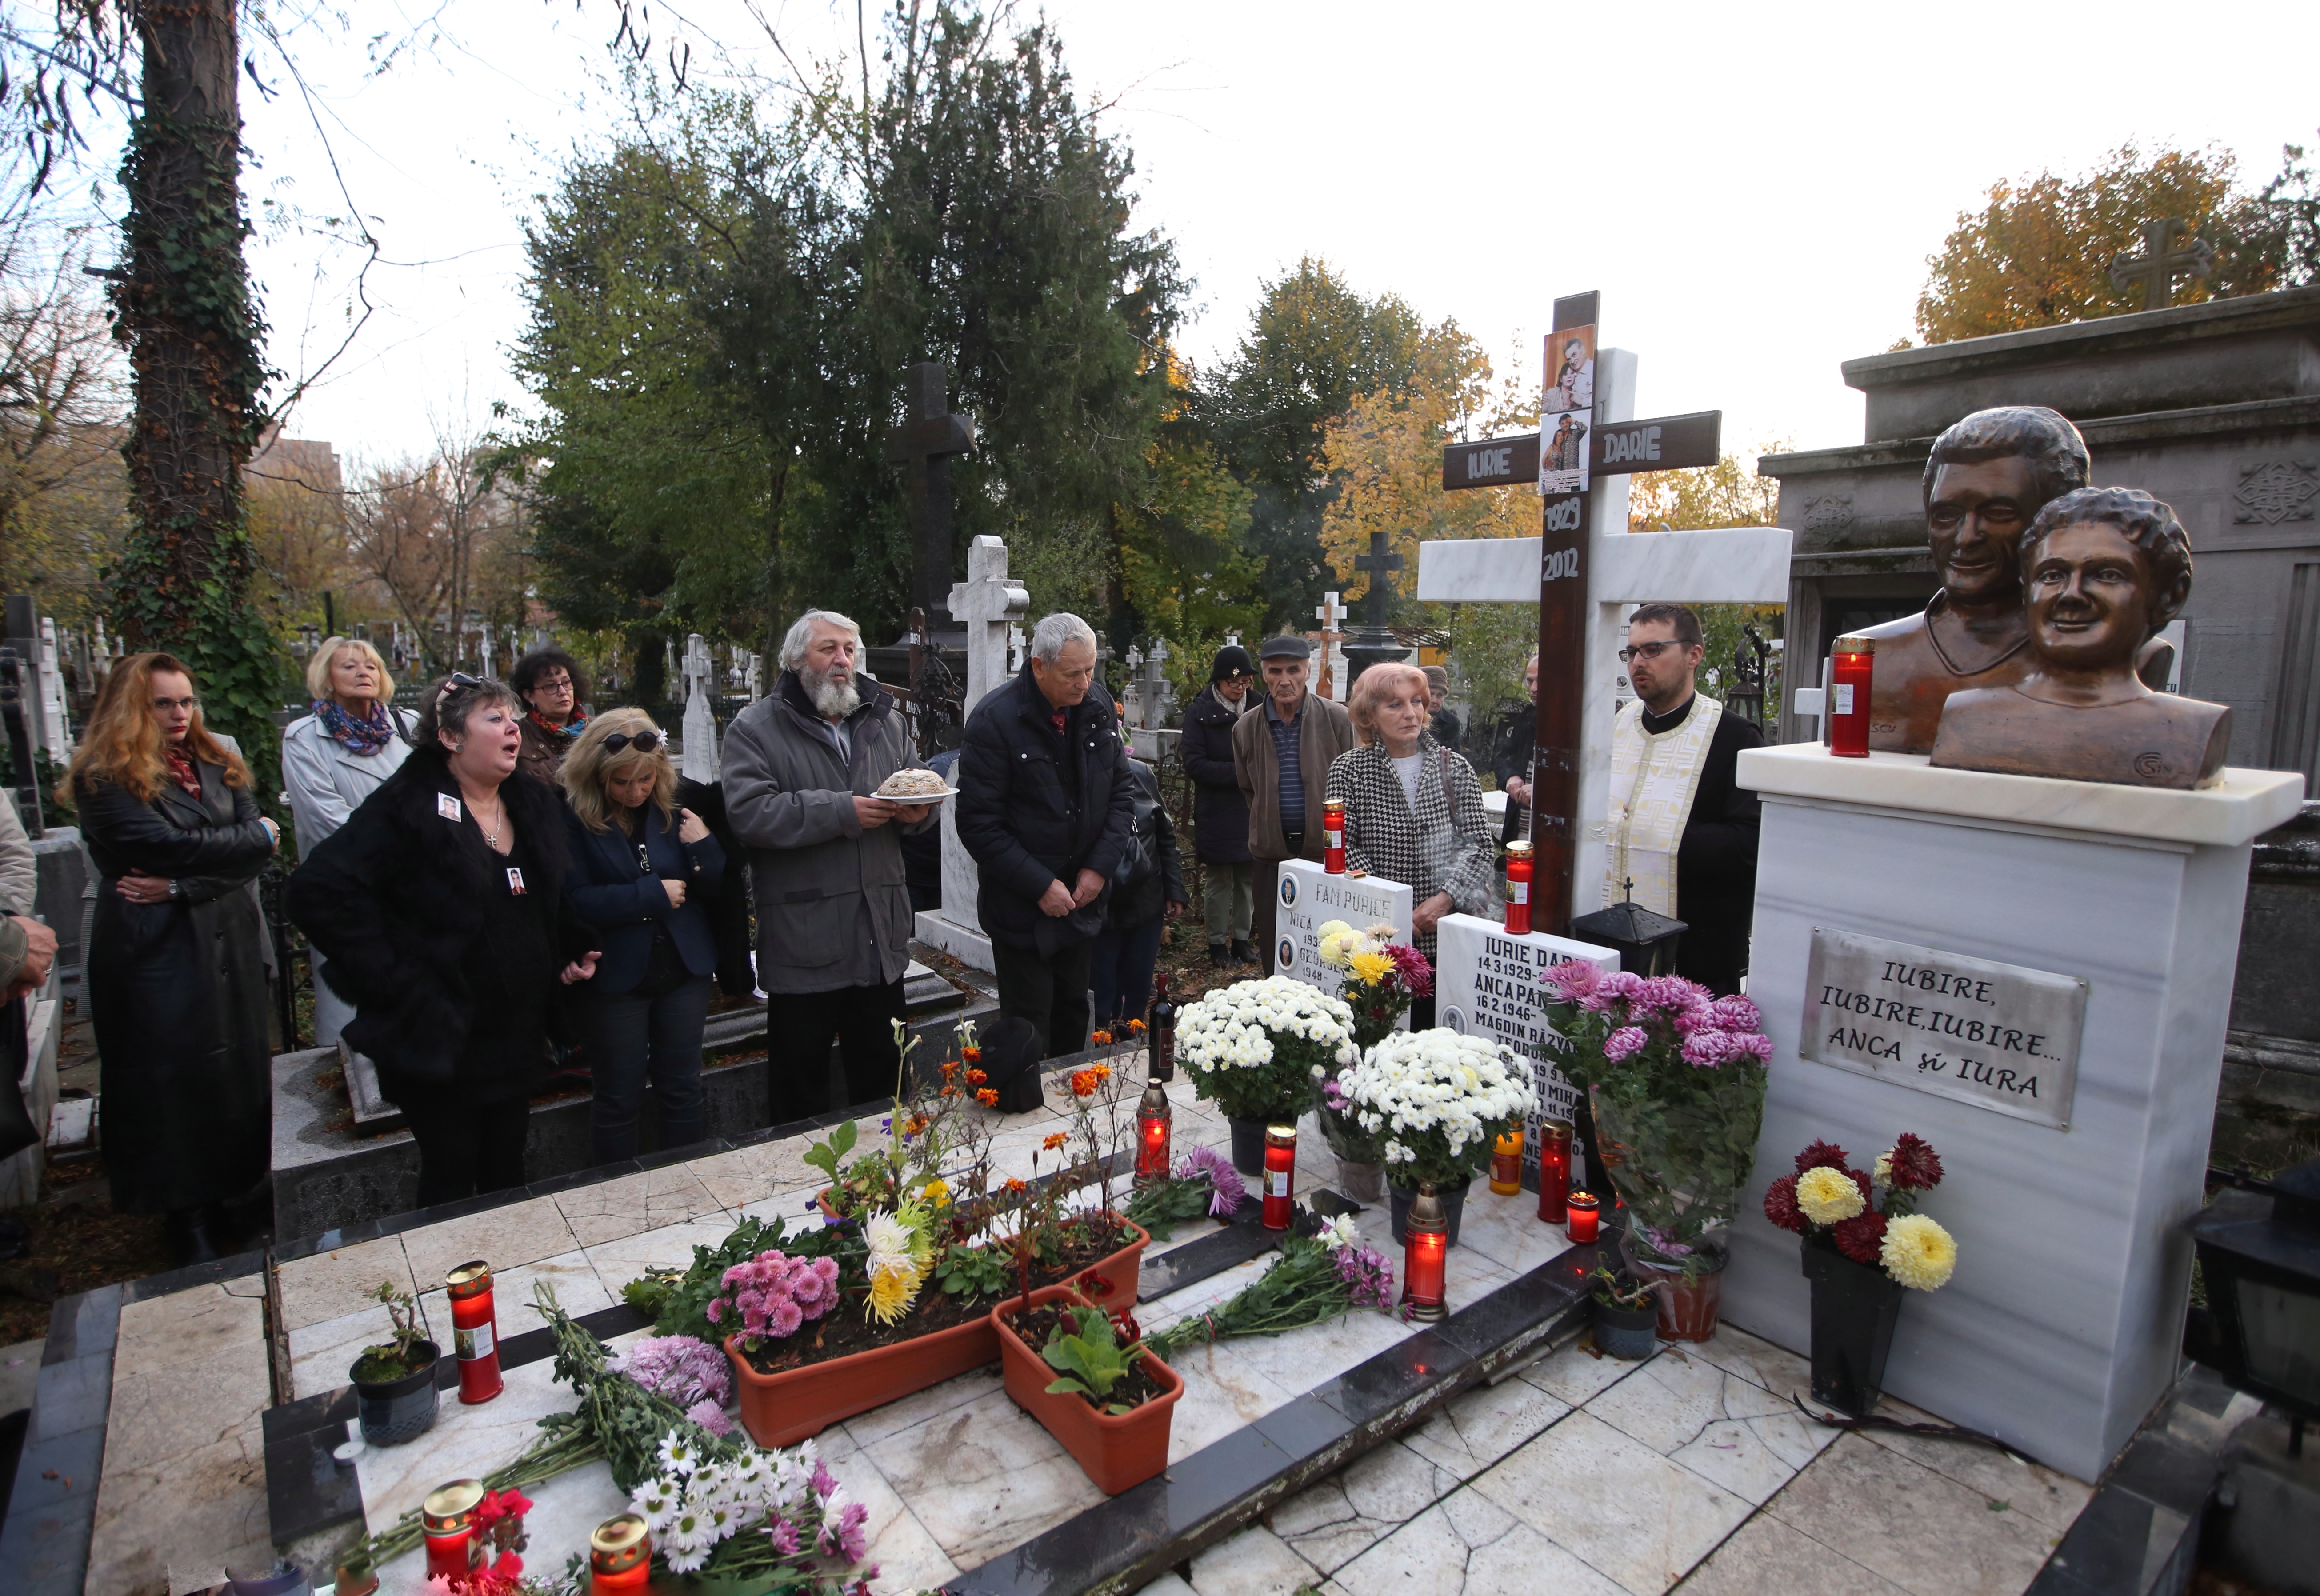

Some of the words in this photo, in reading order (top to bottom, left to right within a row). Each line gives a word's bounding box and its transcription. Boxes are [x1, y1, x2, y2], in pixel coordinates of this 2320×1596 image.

[1603, 426, 1661, 464] DARIE
[1468, 448, 1511, 480] IURIE
[1544, 497, 1581, 531] 1929
[1542, 547, 1578, 581] 2012
[1316, 884, 1340, 907] FAM
[1304, 934, 1320, 947] 193
[1486, 936, 1531, 965] IURIE
[1303, 967, 1322, 981] 1948
[1881, 961, 1995, 1006] IUBIRE,
[1474, 973, 1514, 1000] ANCA
[1516, 983, 1548, 1009] PAN
[1475, 1010, 1526, 1039] MAGDIN
[1829, 1027, 1901, 1062] ANCA
[1956, 1058, 2038, 1098] IURA
